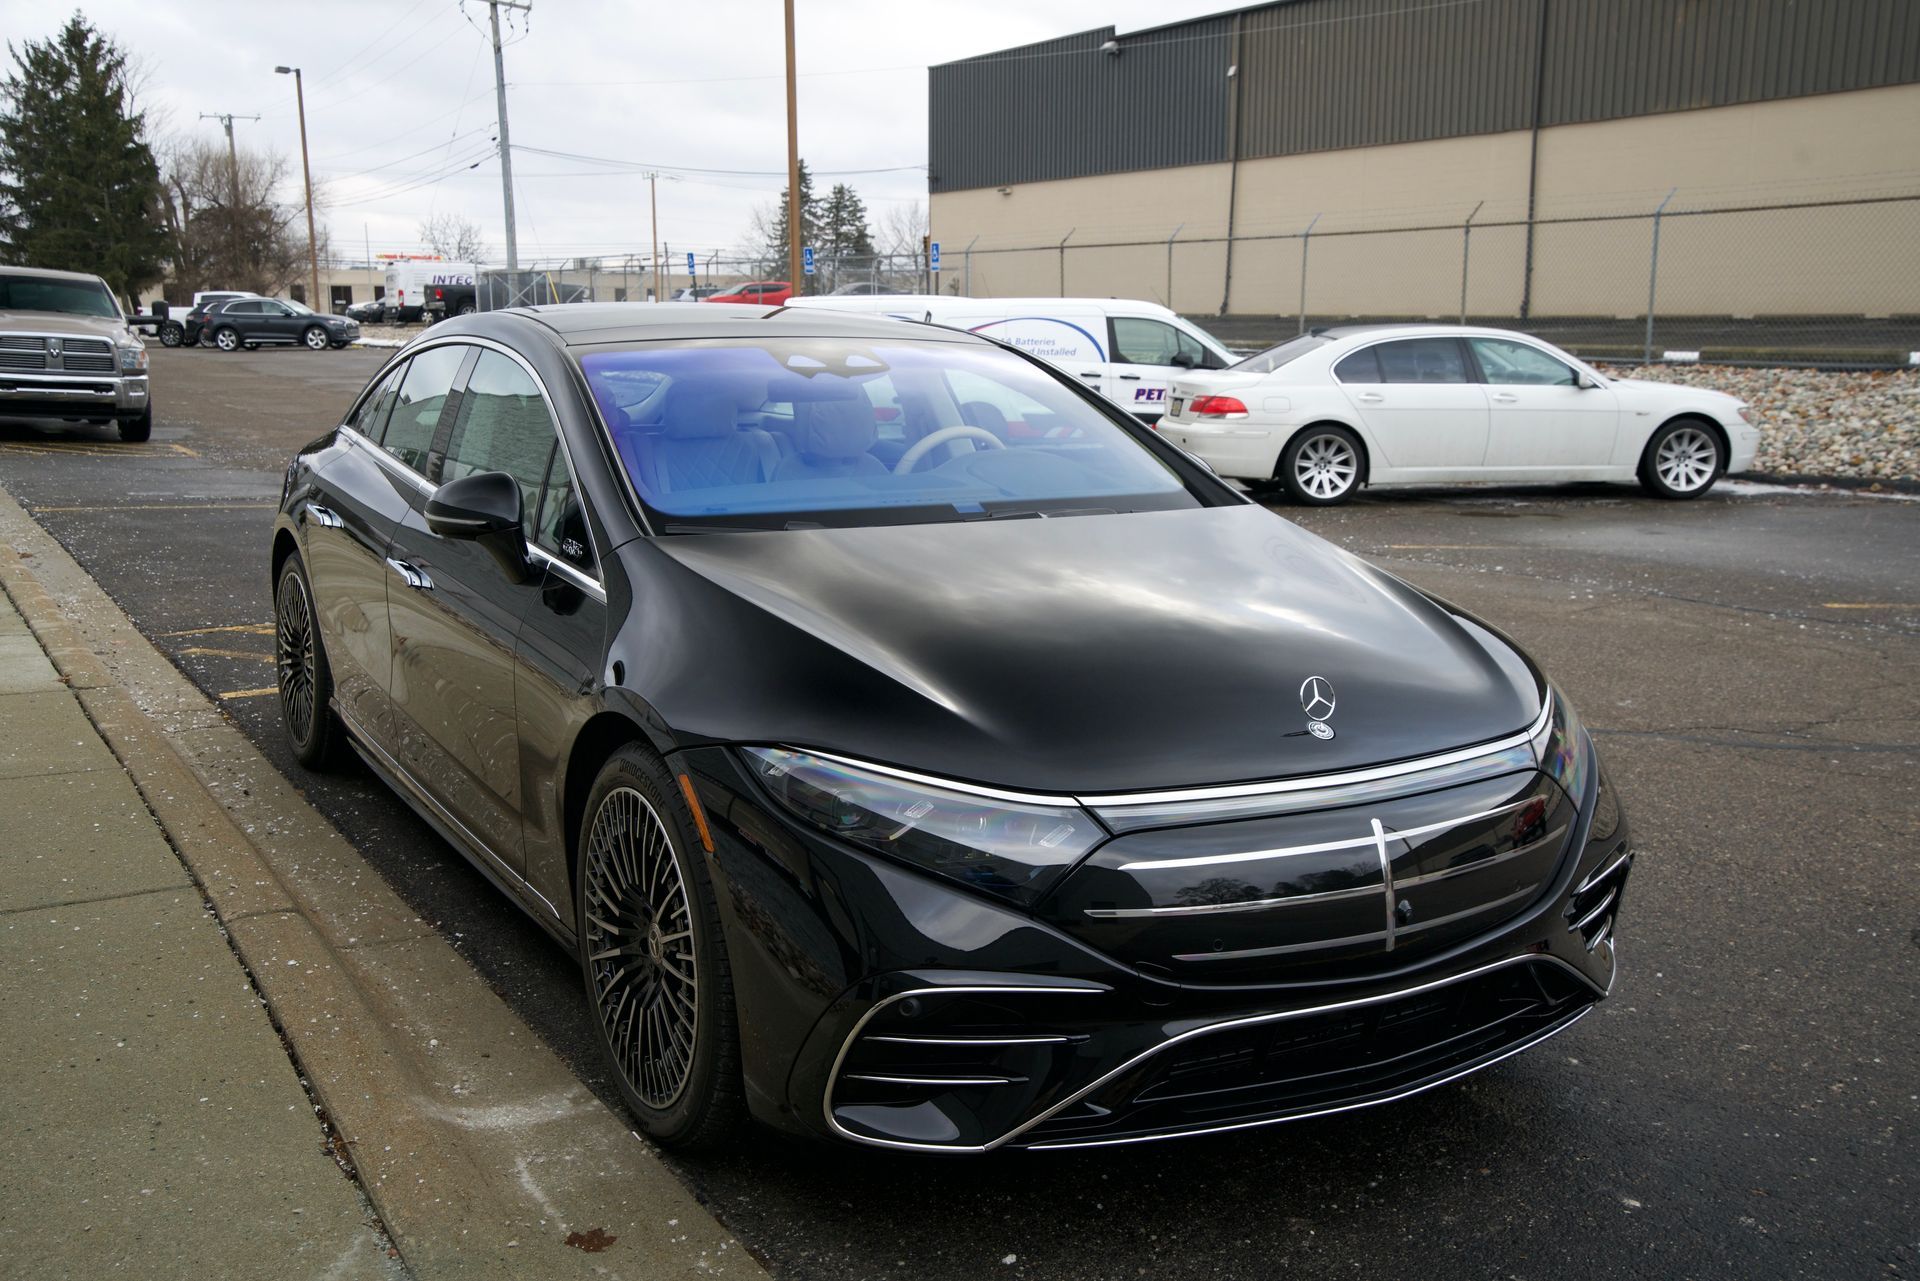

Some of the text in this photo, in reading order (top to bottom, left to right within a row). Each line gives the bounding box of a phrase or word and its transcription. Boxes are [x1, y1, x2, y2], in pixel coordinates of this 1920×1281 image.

[1015, 337, 1056, 346] Batteries
[1036, 348, 1077, 356] Installed
[619, 758, 666, 813] BRIDGESTONE
